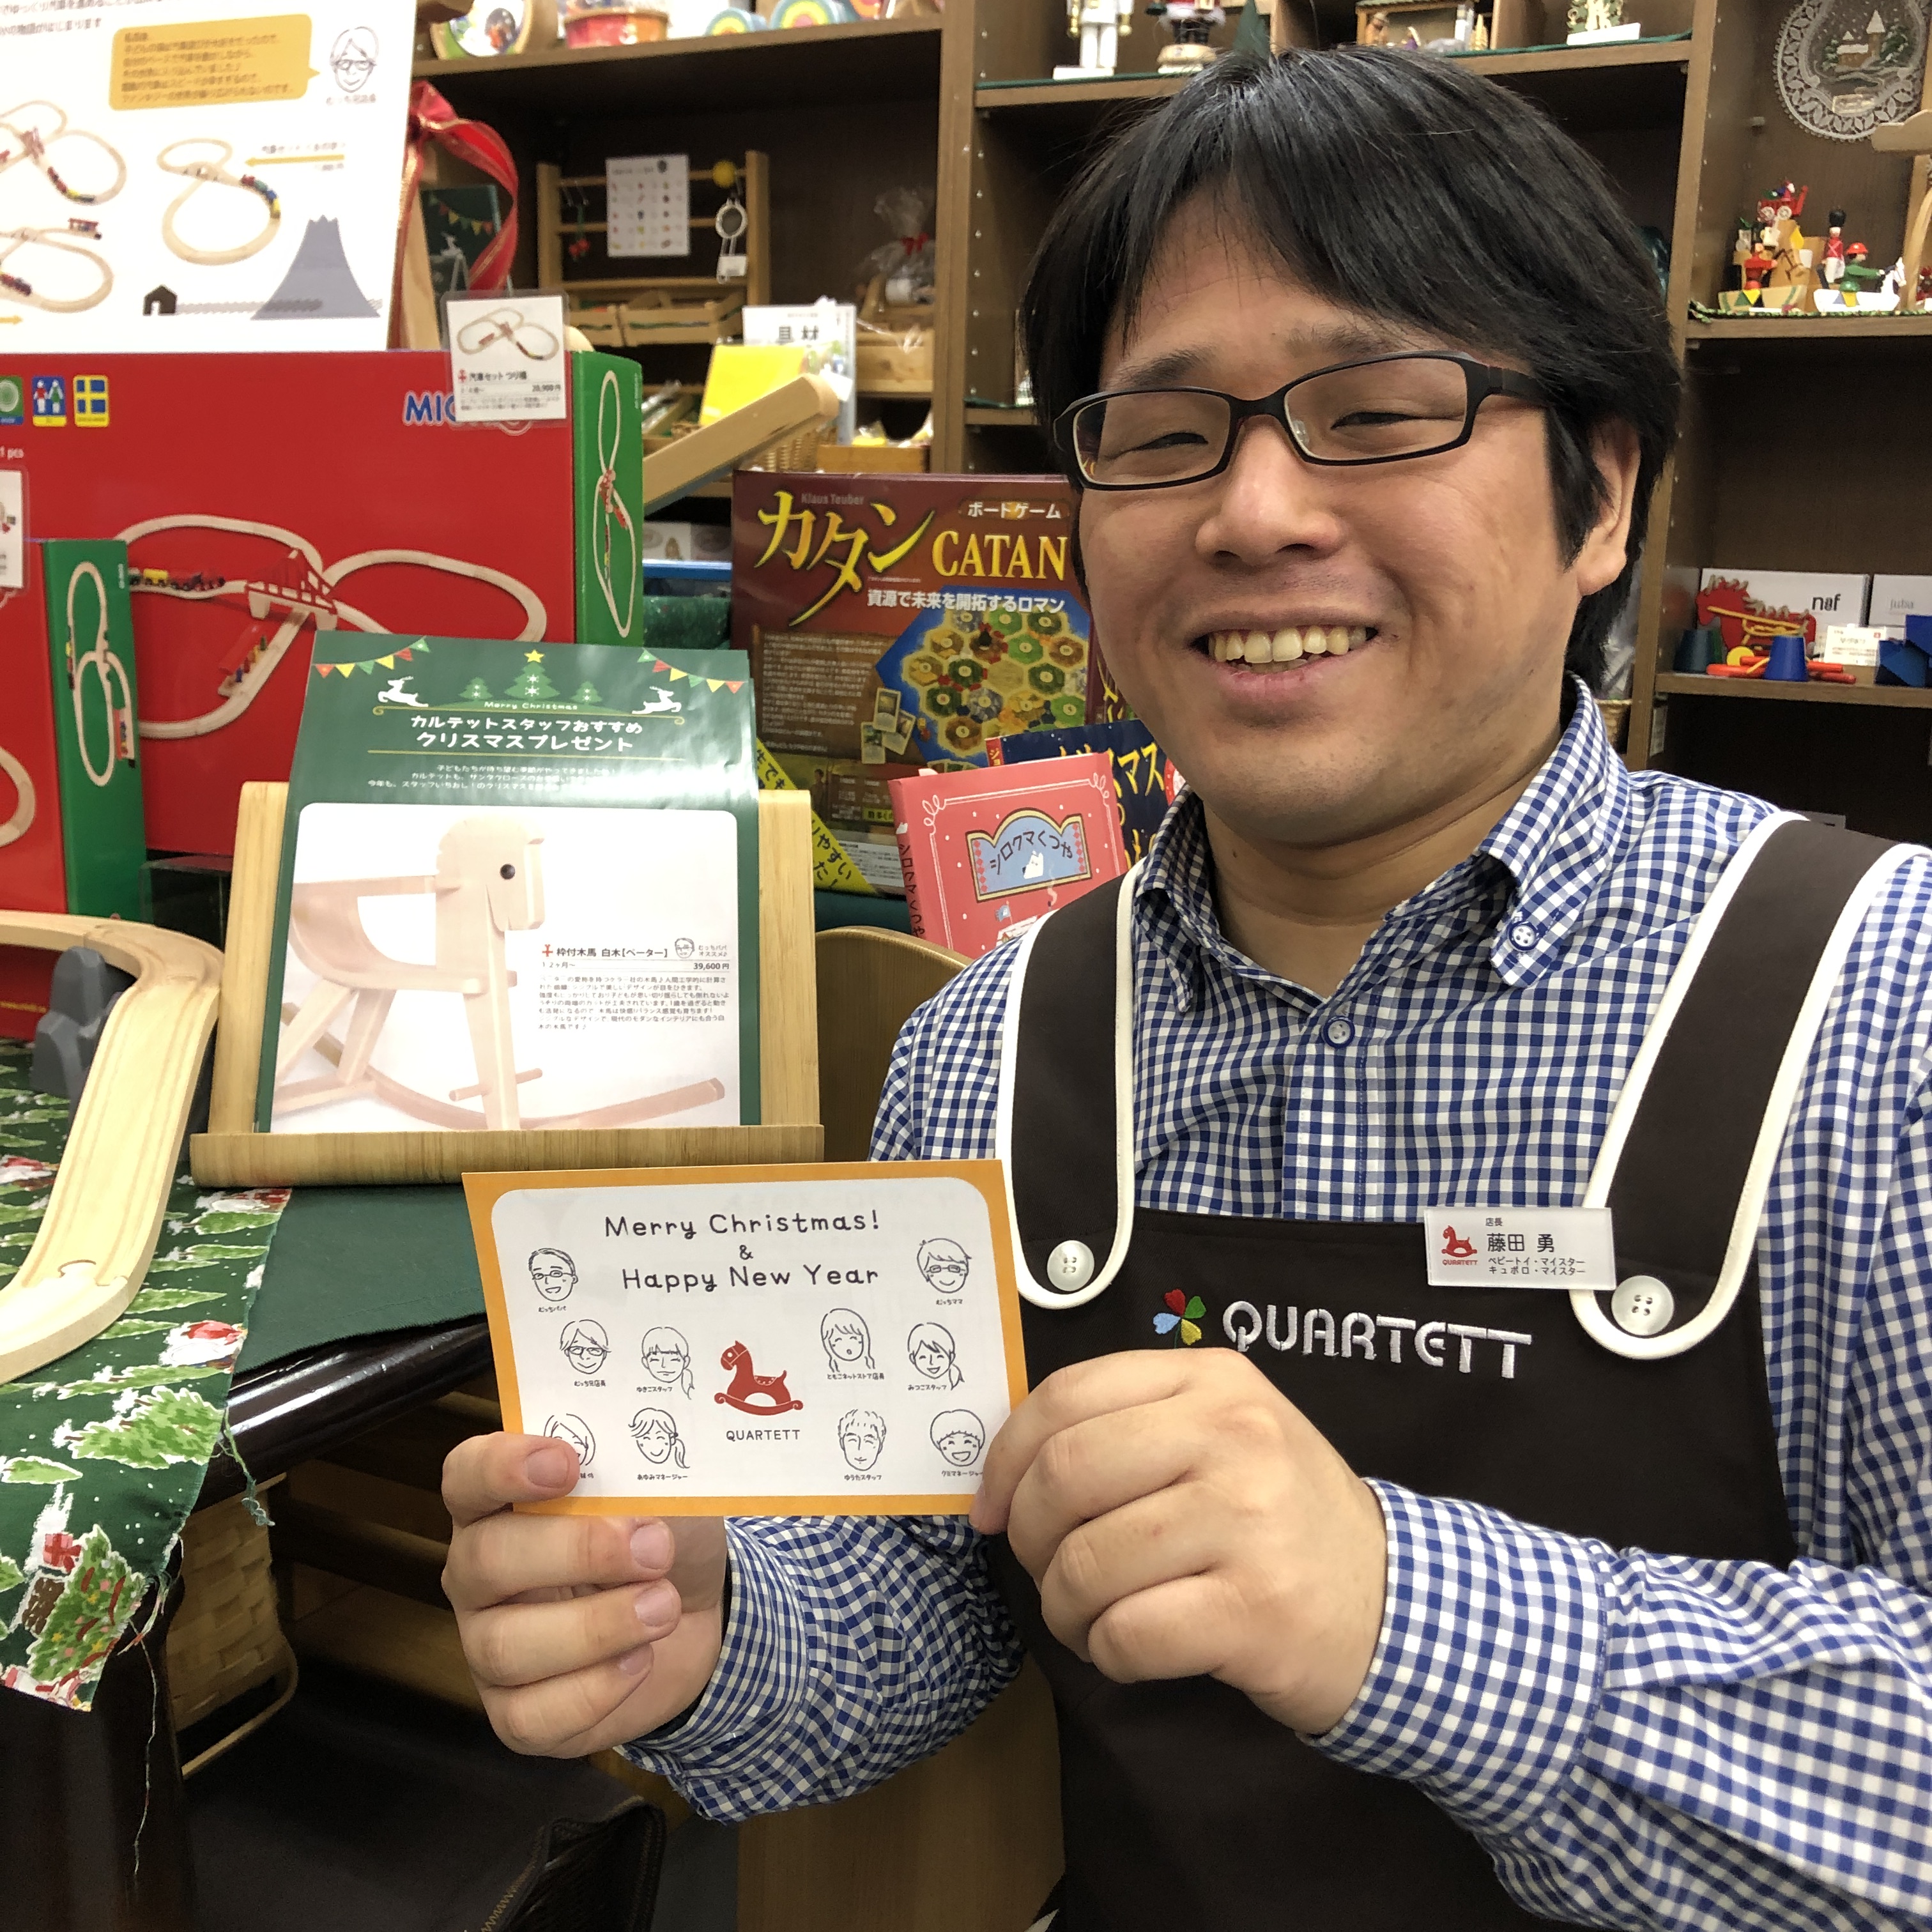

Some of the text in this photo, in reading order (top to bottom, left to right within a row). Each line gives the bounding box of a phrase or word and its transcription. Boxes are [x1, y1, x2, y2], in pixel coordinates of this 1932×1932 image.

[405, 394, 457, 422] MIC
[801, 493, 865, 505] Klaus Teuber
[755, 490, 935, 627] カタン
[932, 530, 1069, 581] CATAN
[866, 589, 1066, 614] 資源で未来を開拓するロマン
[1811, 594, 1841, 612] naf
[484, 702, 578, 710] Merry Christmas
[410, 715, 643, 735] カルテットスタッフおすすめ
[416, 732, 633, 752] クリスマスプレゼント
[989, 830, 1073, 876] シロクマくつや
[898, 843, 925, 937] シロクマくつや
[605, 1209, 879, 1239] Merry Christmas!
[1485, 1217, 1503, 1227] 店長
[739, 1245, 754, 1261] &
[1486, 1232, 1555, 1253] 藤田 勇
[622, 1264, 878, 1292] Happy New Year
[1222, 1300, 1532, 1379] QUARTETT
[726, 1429, 801, 1442] QUARTETT
